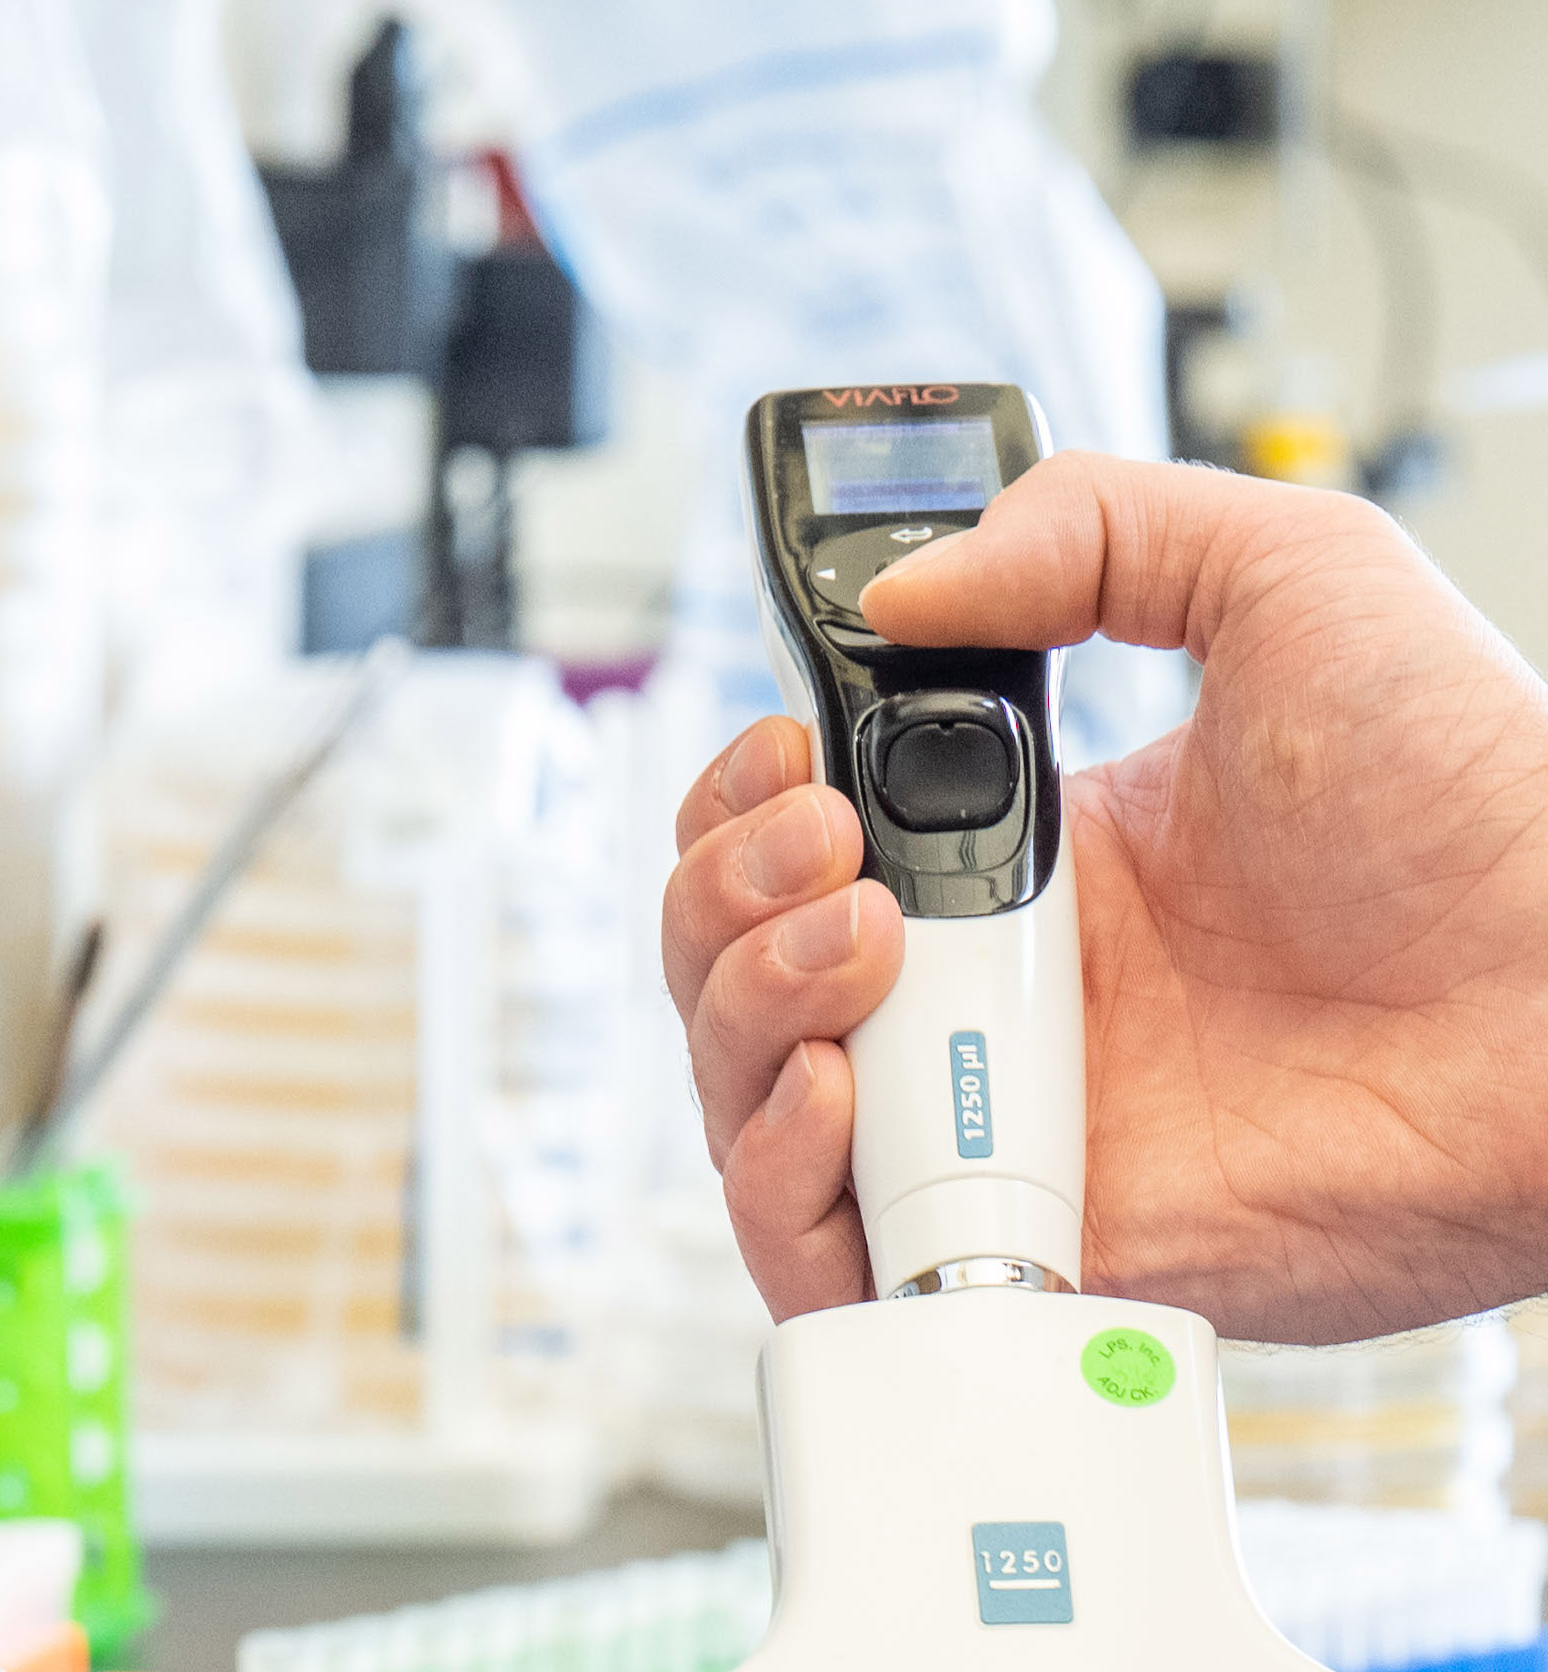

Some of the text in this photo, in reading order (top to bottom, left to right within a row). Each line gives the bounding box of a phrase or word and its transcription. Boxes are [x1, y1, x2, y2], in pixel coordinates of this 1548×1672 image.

[823, 385, 959, 408] VIAFLO
[959, 1075, 985, 1141] 1250
[980, 1550, 1062, 1574] 1250
